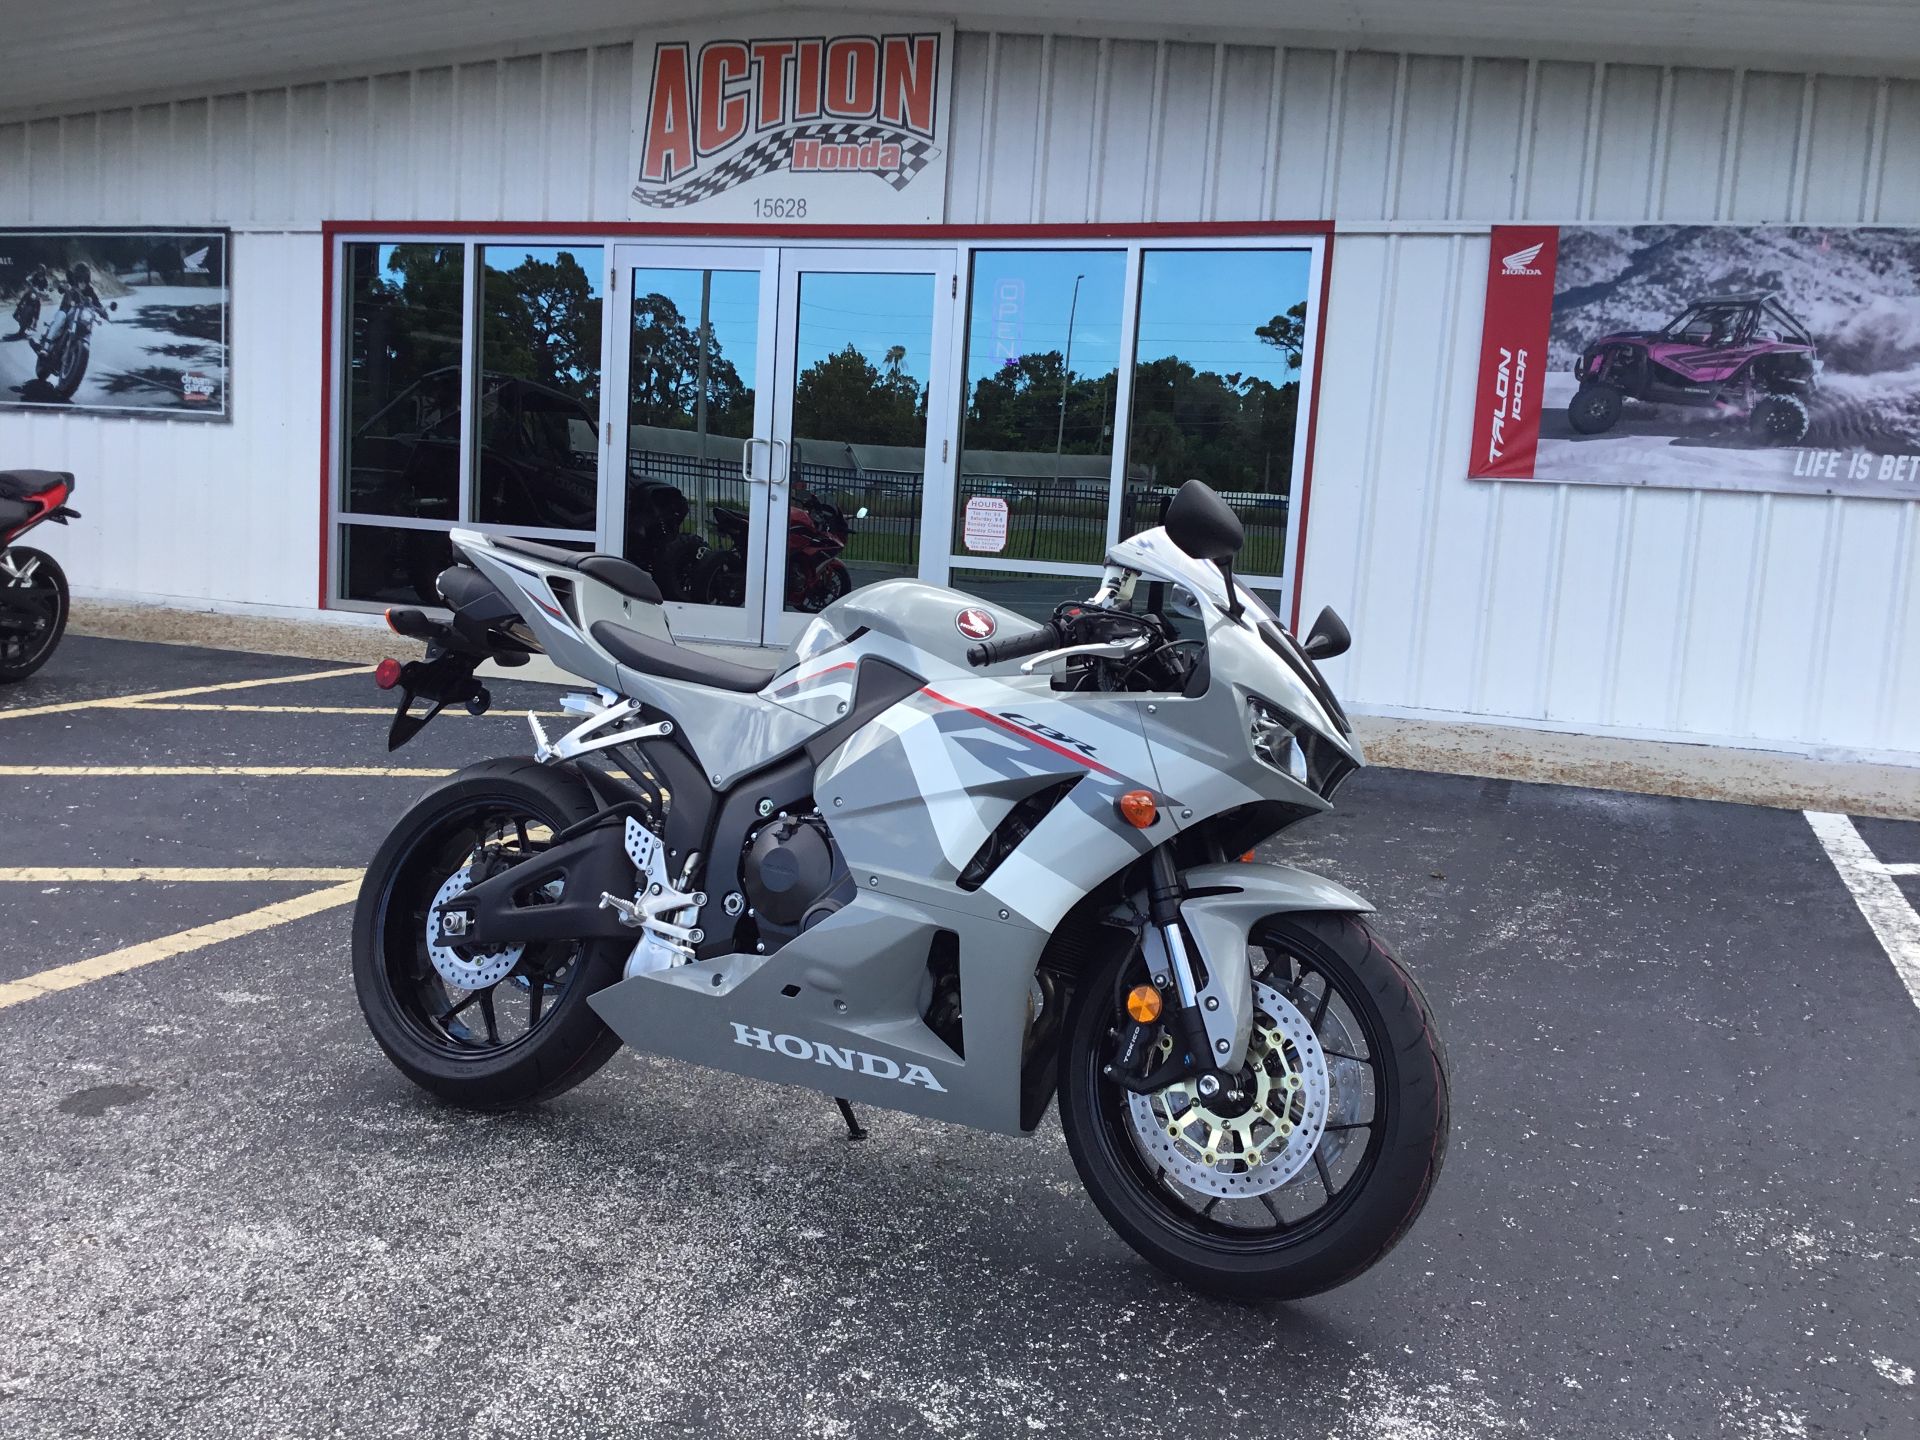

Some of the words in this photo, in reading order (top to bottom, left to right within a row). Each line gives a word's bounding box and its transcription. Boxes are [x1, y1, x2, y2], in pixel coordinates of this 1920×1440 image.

[639, 32, 941, 183] ACTION
[790, 137, 902, 172] Honda
[753, 198, 807, 218] 15628
[995, 284, 1018, 358] OPEN
[183, 383, 214, 396] garage
[1489, 347, 1512, 464] TALON
[1512, 349, 1528, 421] 1000R
[1793, 450, 1842, 478] LIFE
[1848, 453, 1872, 480] IS
[1878, 454, 1920, 482] BET
[998, 712, 1098, 760] CBR
[730, 1022, 948, 1093] HONDA
[1123, 1026, 1140, 1063] TOKICO
